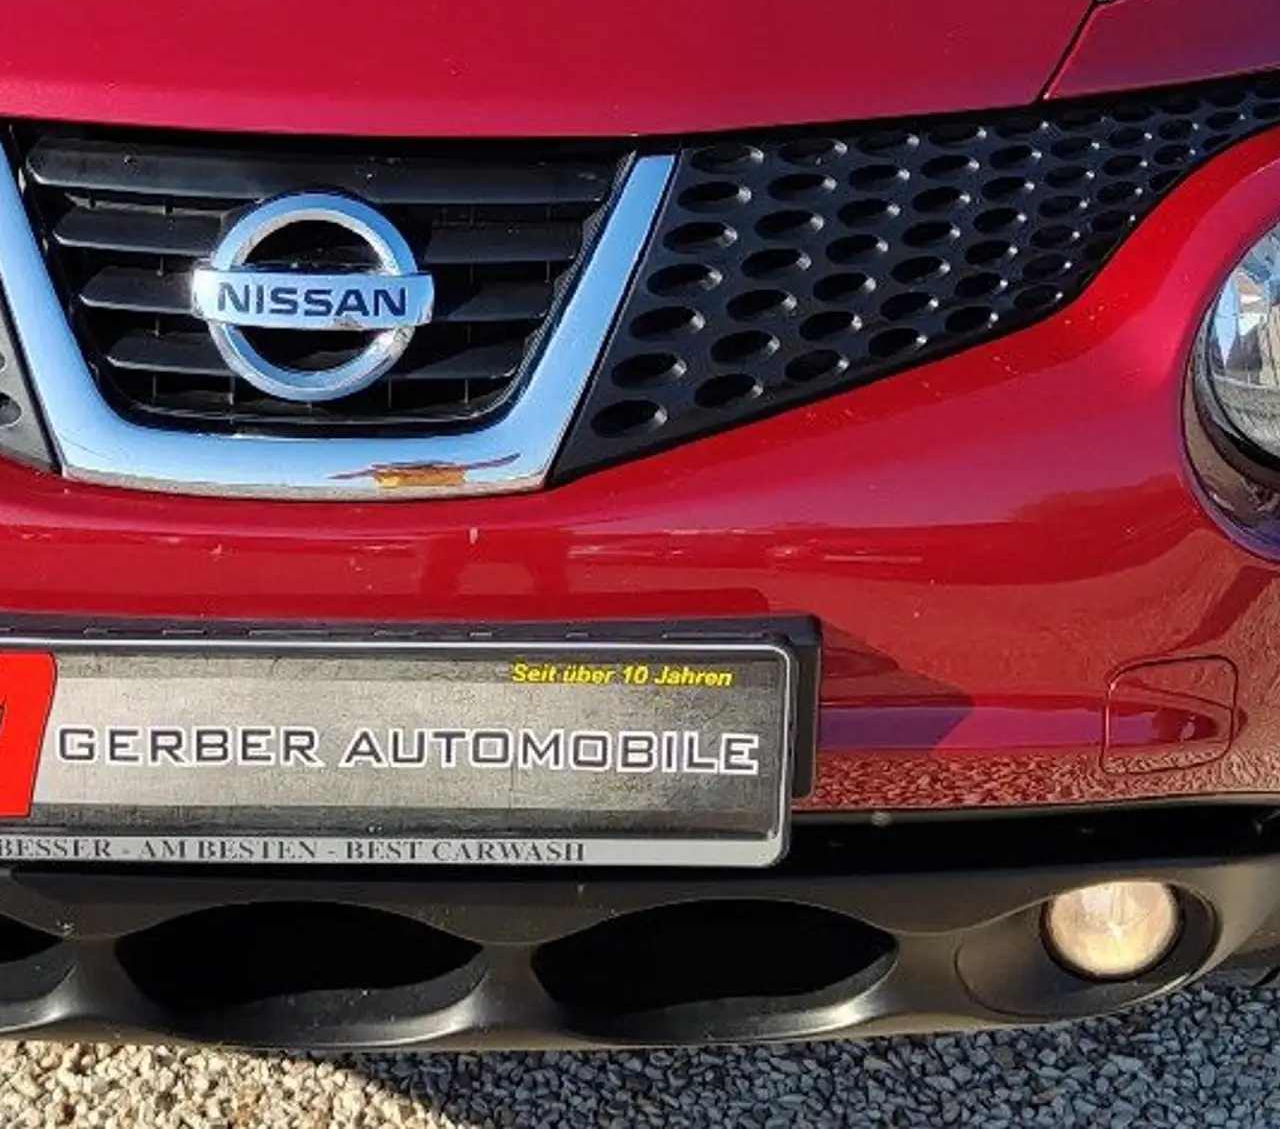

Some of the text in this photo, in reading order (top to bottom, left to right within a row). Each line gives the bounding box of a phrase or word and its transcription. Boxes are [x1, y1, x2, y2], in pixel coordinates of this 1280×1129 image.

[219, 282, 405, 317] NISSAN
[512, 663, 732, 688] Seit über 10 Jahren
[58, 726, 759, 775] GERBER AUTOMOBILE
[139, 838, 187, 859] AM
[197, 839, 318, 861] BESTEN
[345, 840, 423, 860] BEST
[430, 840, 586, 863] CARWASH
